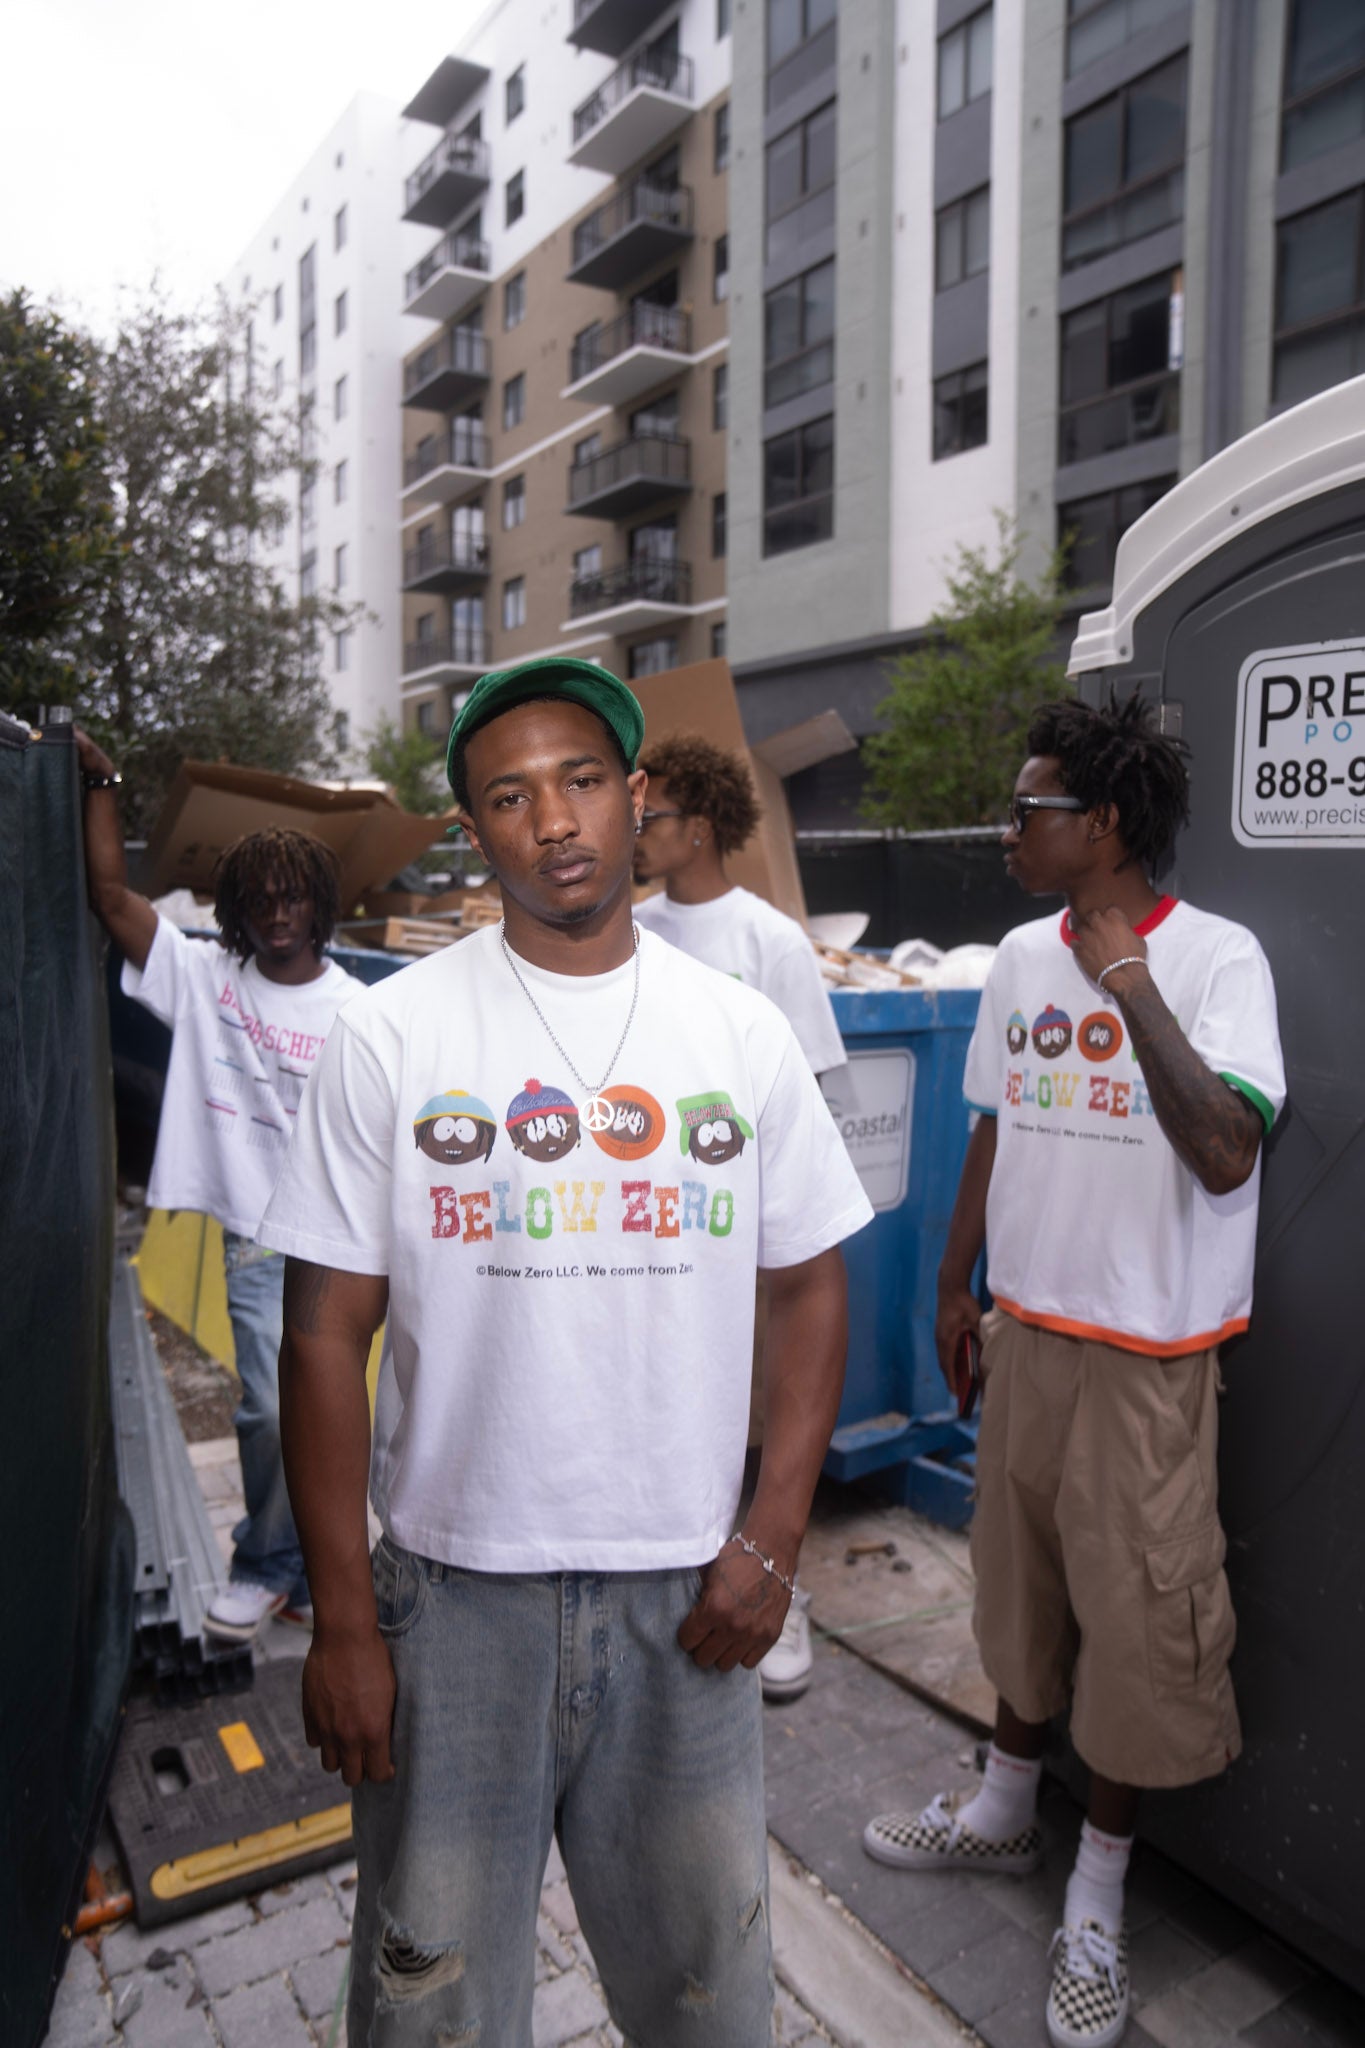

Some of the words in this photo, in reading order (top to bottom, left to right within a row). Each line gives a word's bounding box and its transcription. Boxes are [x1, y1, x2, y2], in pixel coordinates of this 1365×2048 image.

[1259, 671, 1365, 748] PRE
[1305, 720, 1352, 744] PO
[1255, 756, 1365, 800] 888-9
[430, 1180, 606, 1244] BELOW
[621, 1180, 735, 1238] ZERO
[524, 1267, 553, 1278] Zero
[556, 1265, 582, 1278] LLC.
[587, 1265, 607, 1276] We
[610, 1266, 644, 1276] come
[648, 1264, 677, 1275] from
